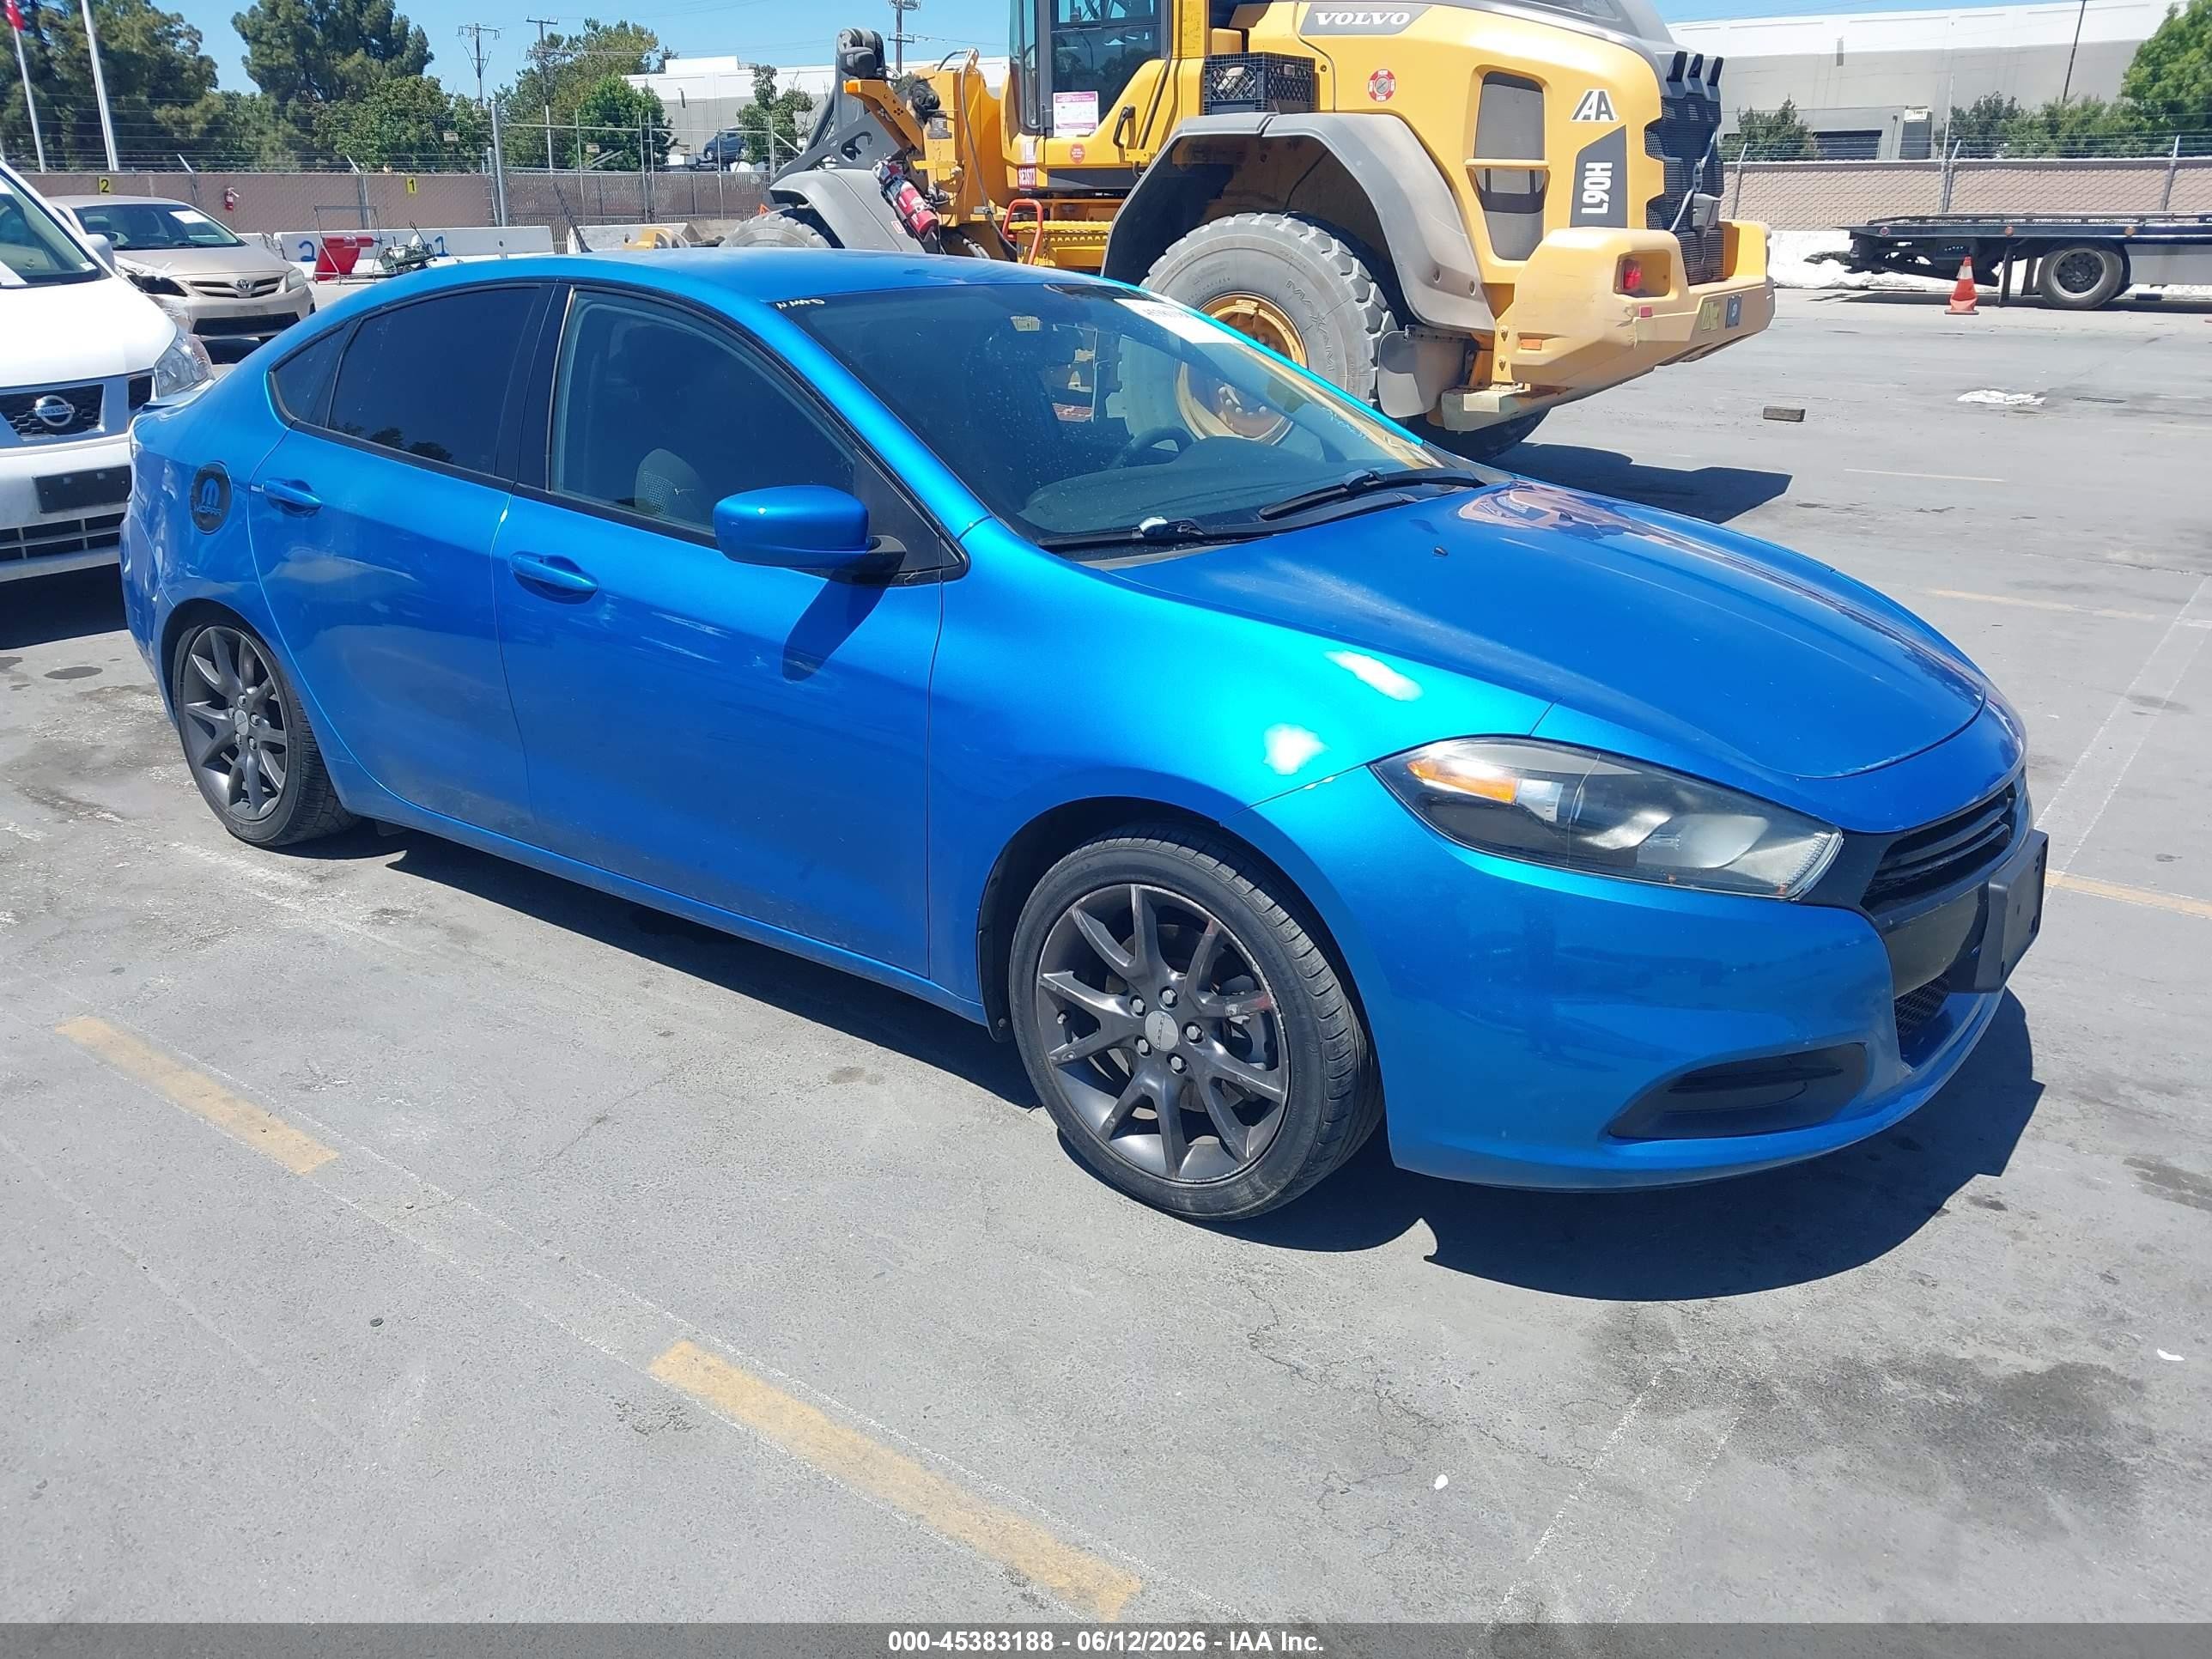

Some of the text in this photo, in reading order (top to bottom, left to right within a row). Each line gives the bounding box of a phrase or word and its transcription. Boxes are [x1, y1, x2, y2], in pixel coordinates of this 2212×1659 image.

[1315, 12, 1410, 25] VOLVO
[100, 179, 110, 193] 2
[409, 178, 416, 191] 1
[1581, 161, 1613, 214] L90H
[298, 240, 317, 262] 2
[434, 235, 450, 257] 1
[40, 405, 72, 416] NISSAN
[193, 505, 222, 517] MOPAR
